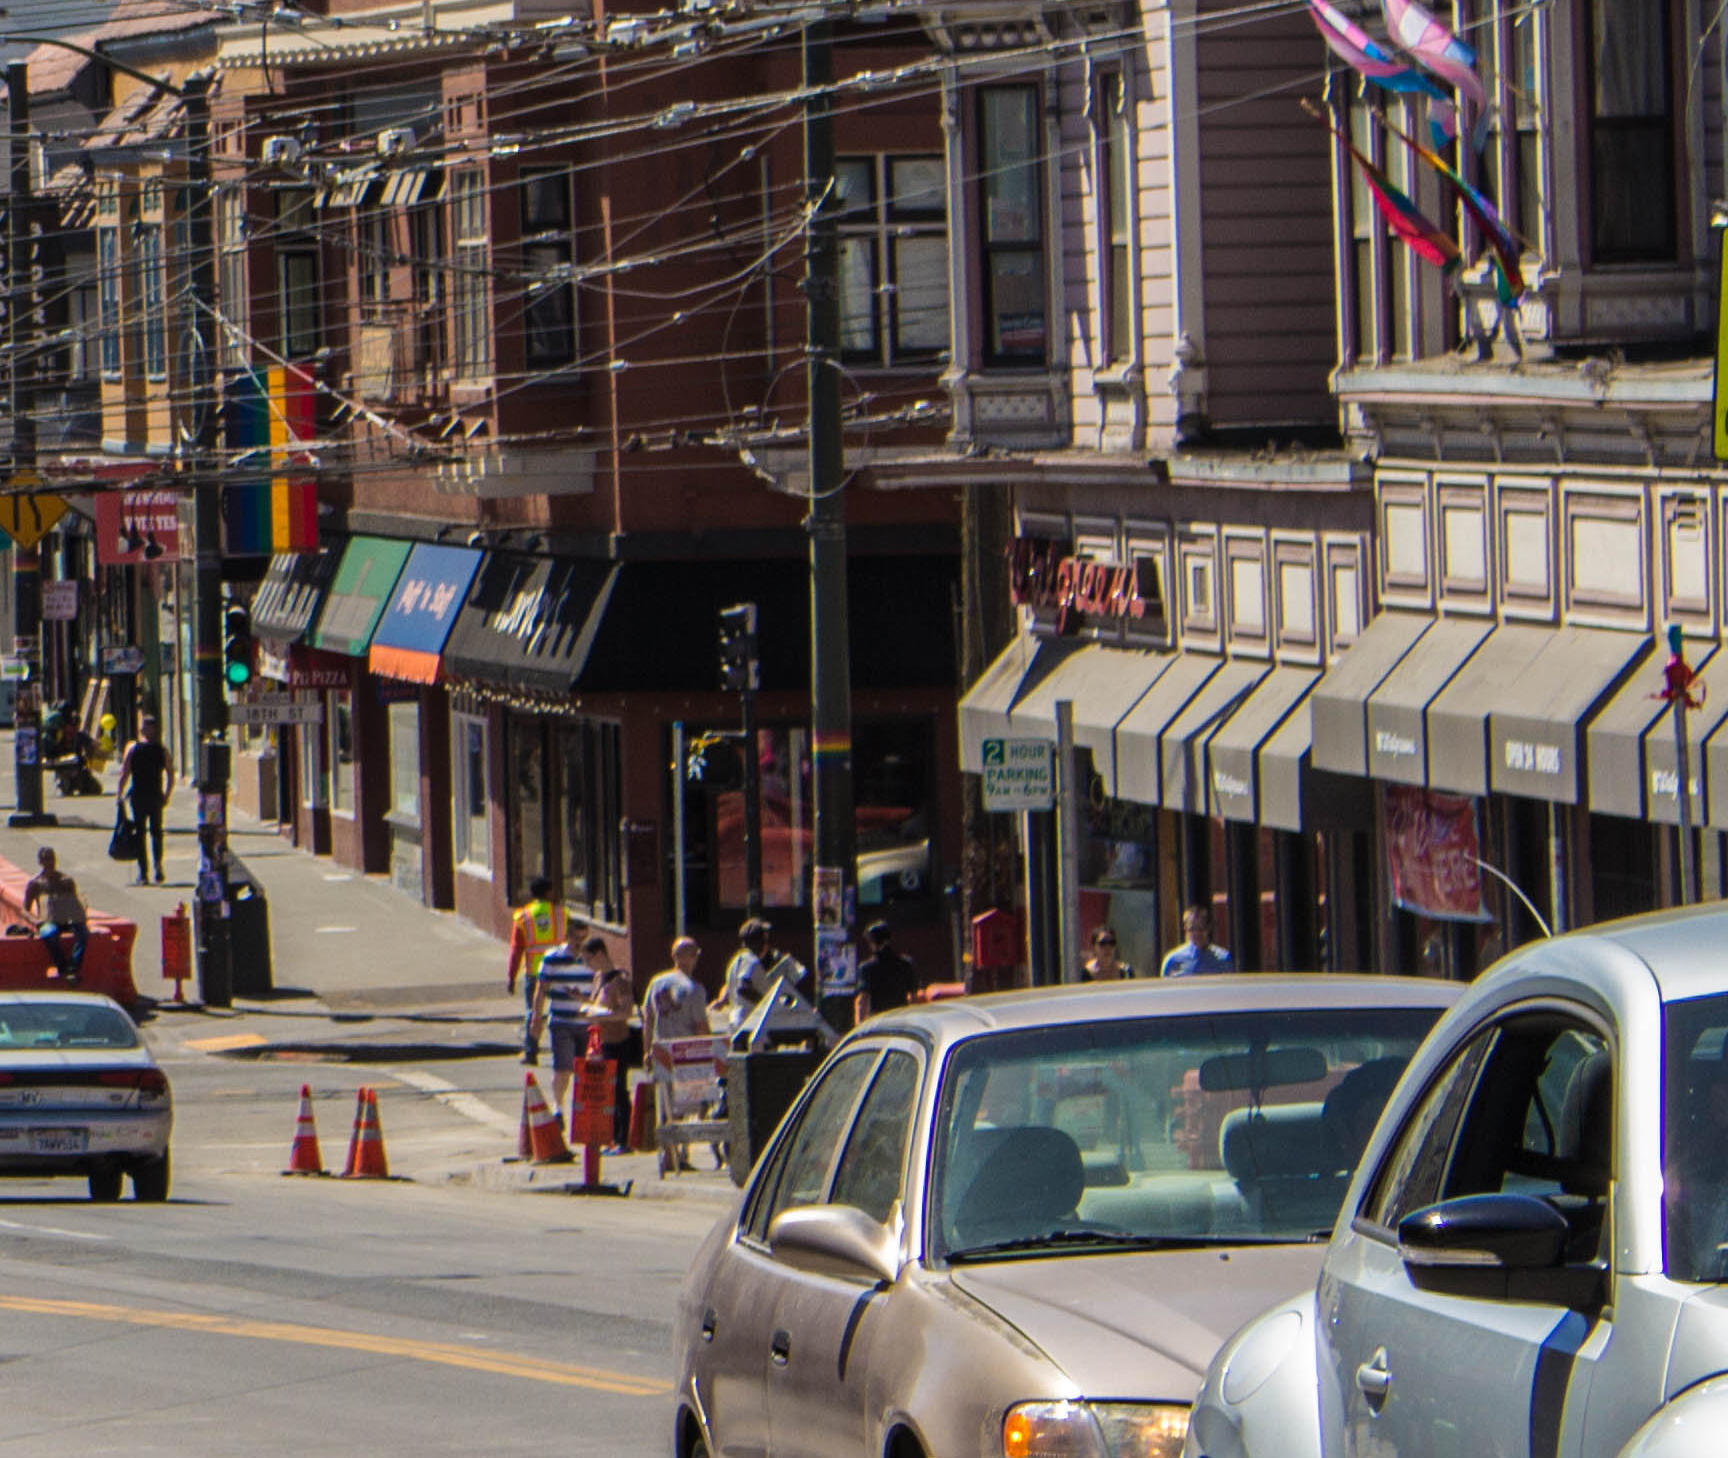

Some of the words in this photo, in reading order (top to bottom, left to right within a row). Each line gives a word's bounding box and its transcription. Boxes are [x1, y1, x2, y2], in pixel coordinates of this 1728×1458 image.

[987, 742, 1002, 766] 2
[1010, 744, 1046, 759] HOUR
[987, 767, 1049, 782] PARKING
